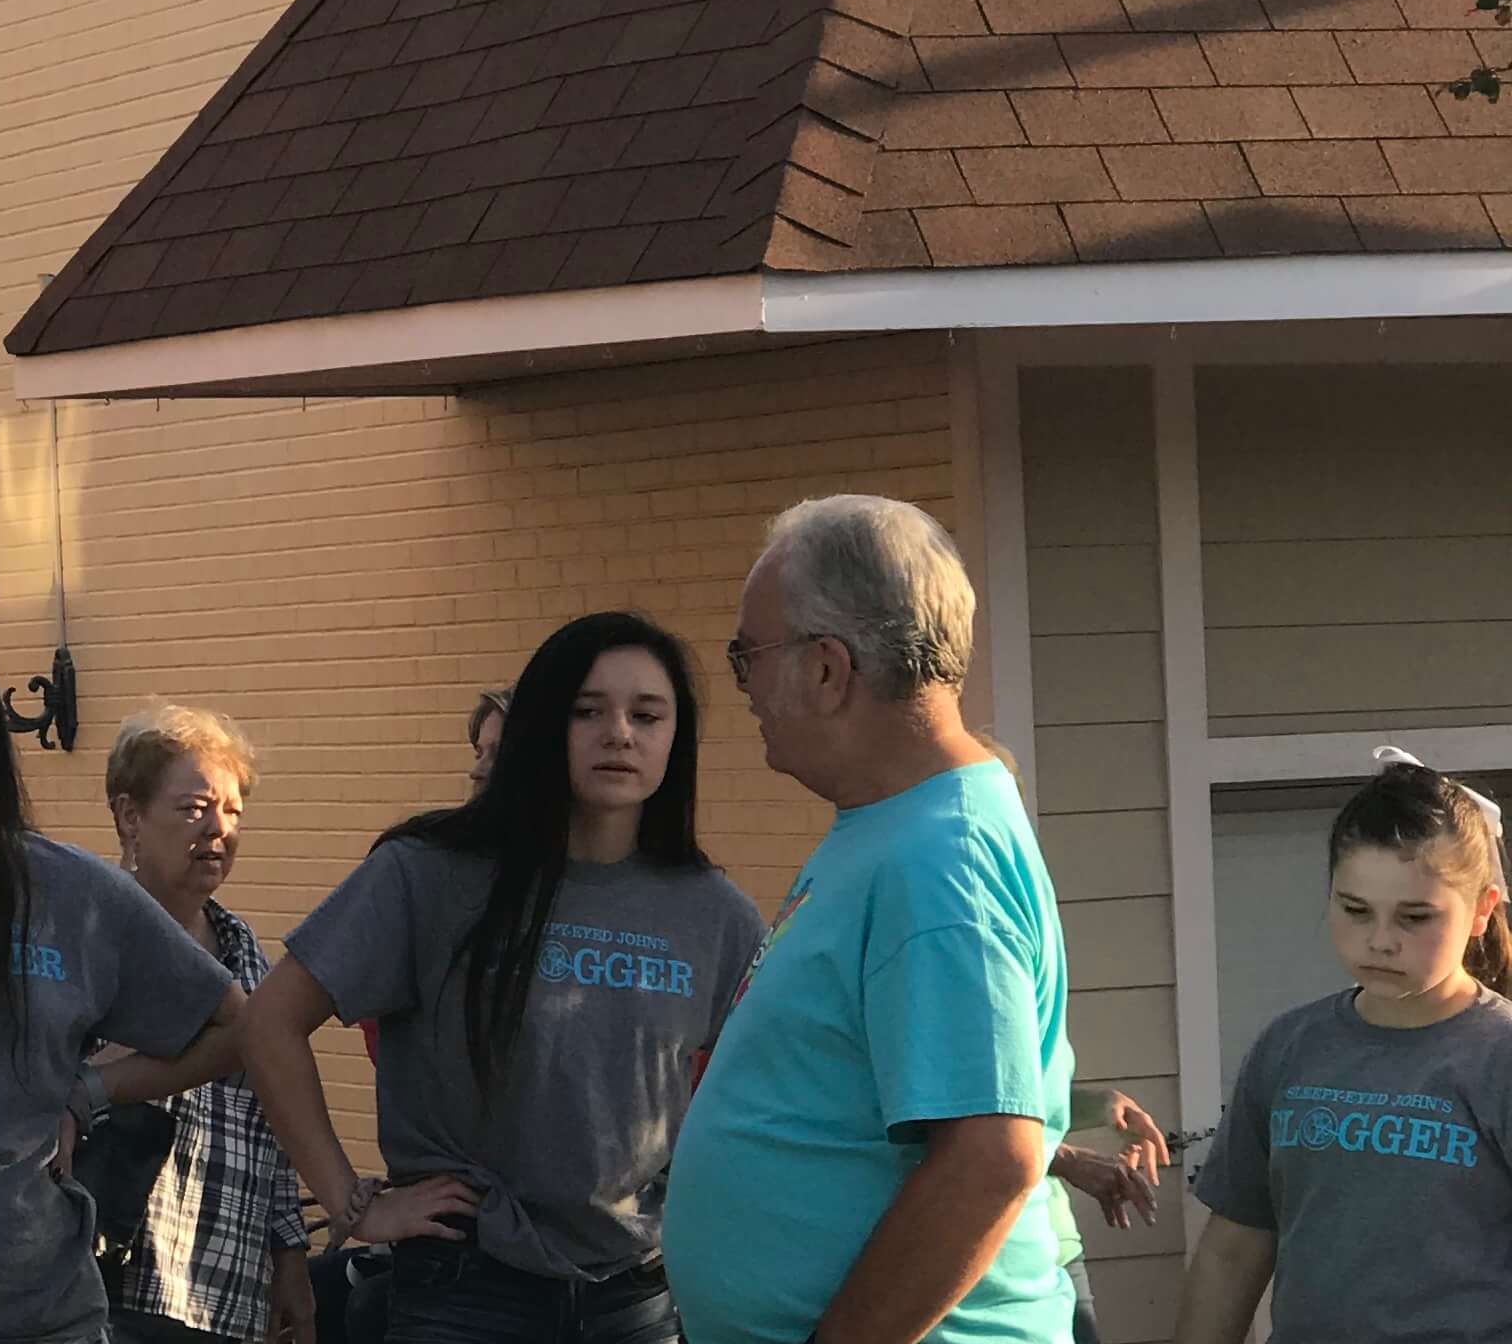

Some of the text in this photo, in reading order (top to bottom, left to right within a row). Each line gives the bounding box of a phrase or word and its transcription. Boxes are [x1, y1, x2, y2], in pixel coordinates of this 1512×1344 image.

[617, 931, 670, 952] JOHN'S
[538, 940, 694, 999] OGGER
[1391, 1093, 1454, 1113] JOHN'S
